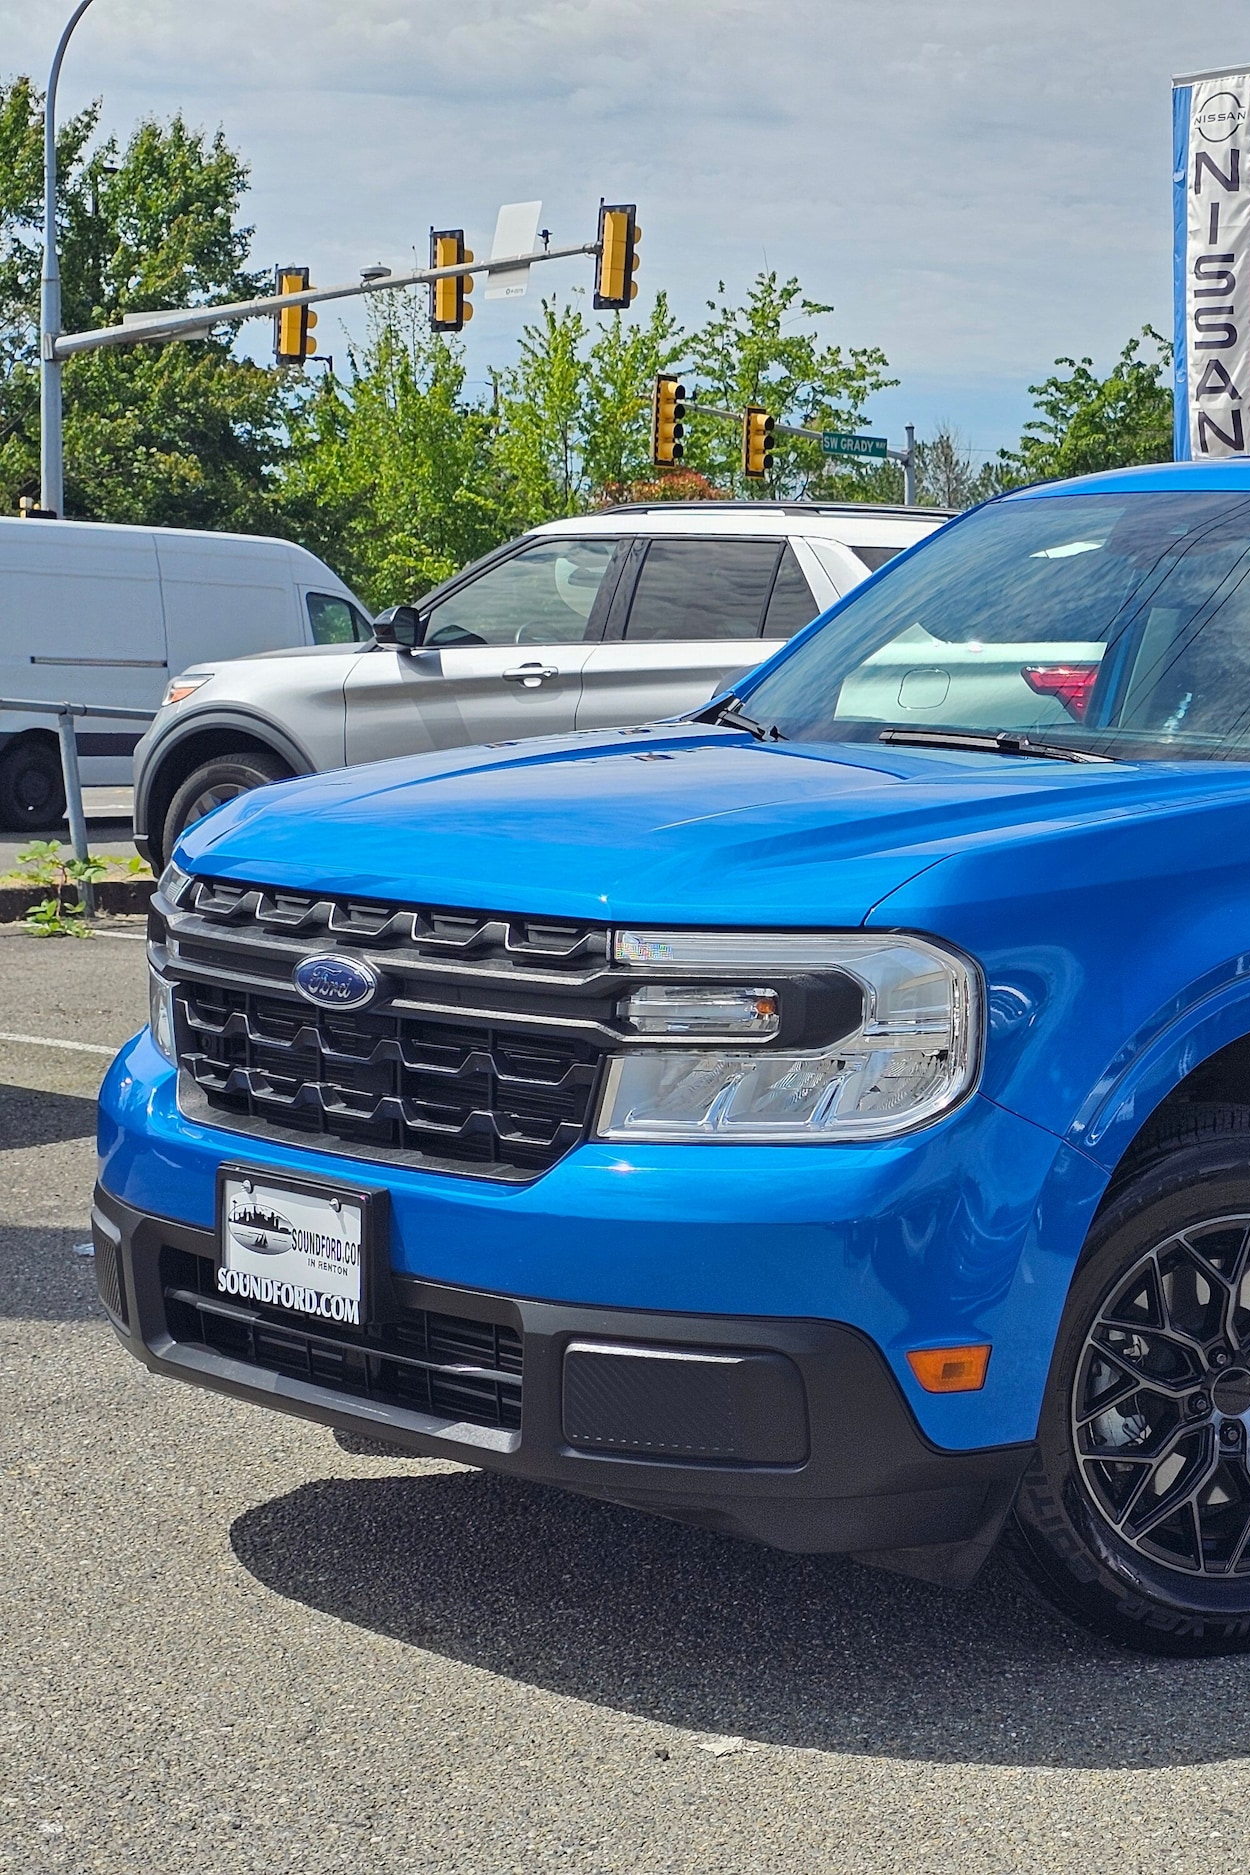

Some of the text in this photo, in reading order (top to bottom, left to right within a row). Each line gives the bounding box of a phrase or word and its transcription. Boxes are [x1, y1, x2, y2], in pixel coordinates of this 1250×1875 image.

[1194, 111, 1246, 125] NISSAN
[1193, 148, 1245, 453] NISSAN
[824, 436, 887, 453] SW GRADY WAY
[307, 965, 352, 998] Ford
[308, 1258, 348, 1276] IN RENTON
[217, 1267, 360, 1325] SOUNDFORD.COM
